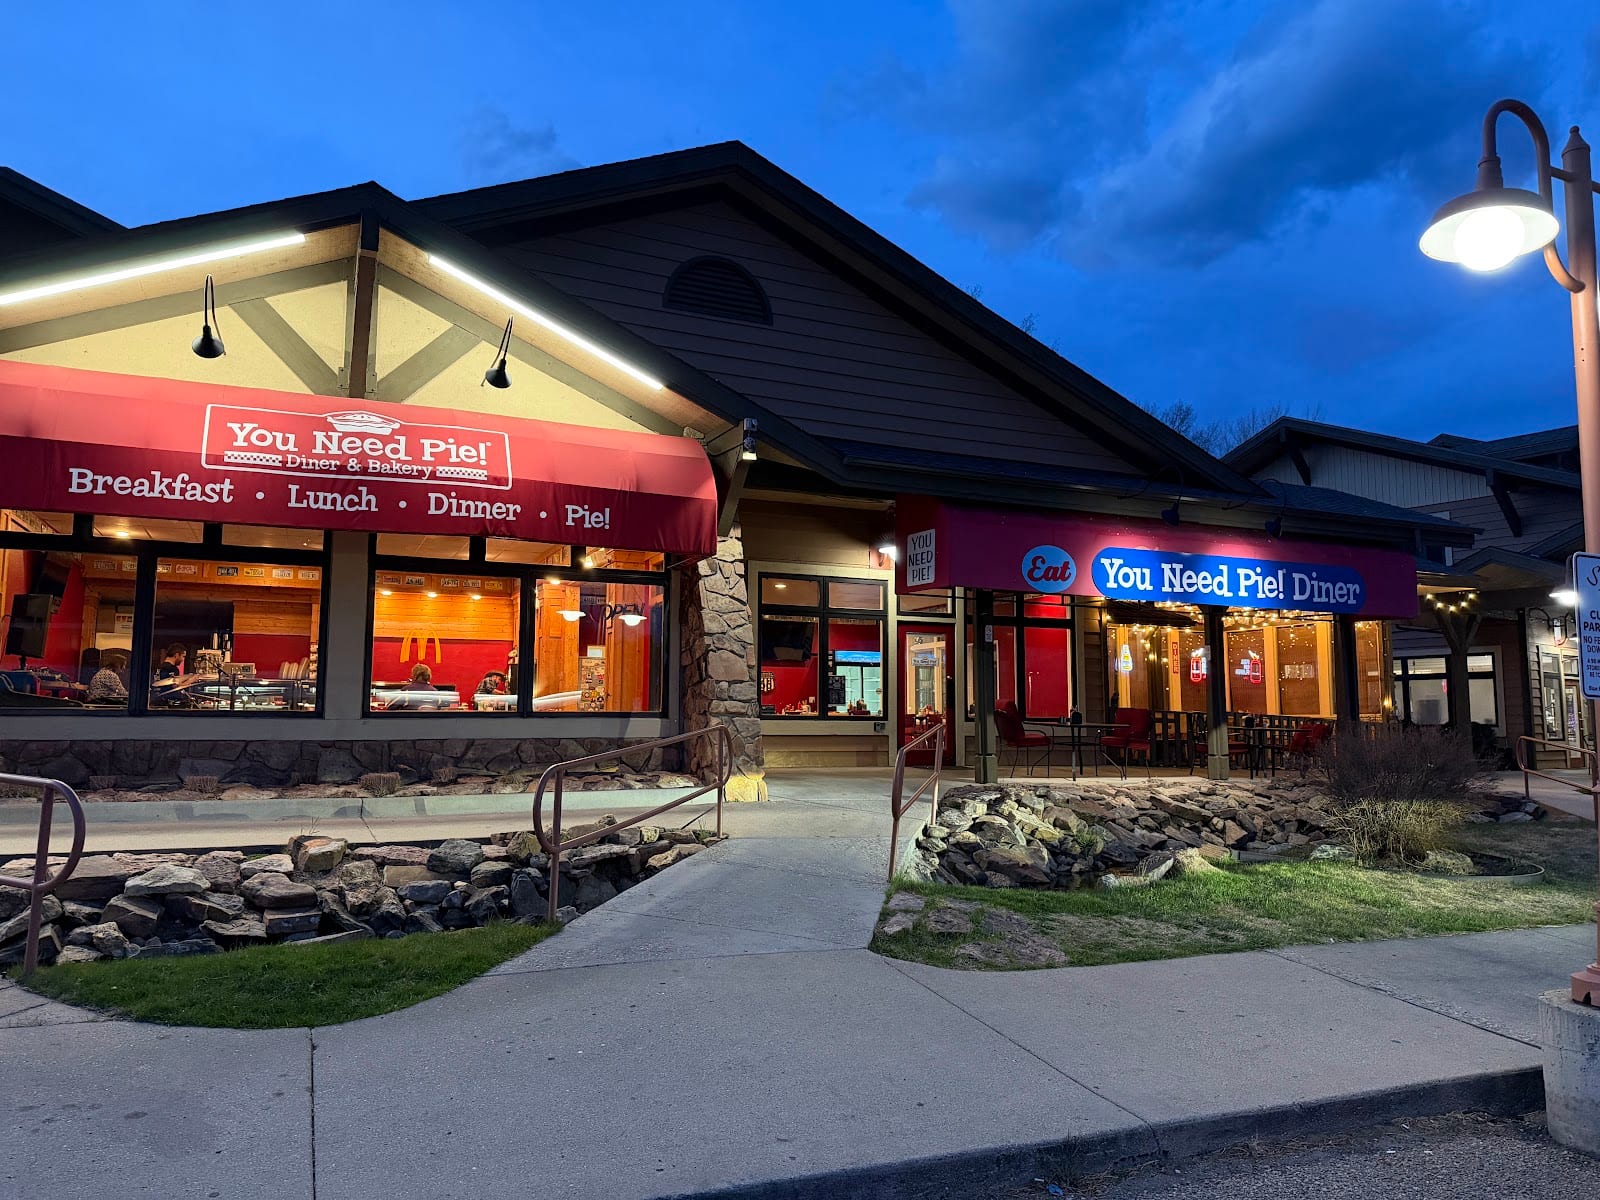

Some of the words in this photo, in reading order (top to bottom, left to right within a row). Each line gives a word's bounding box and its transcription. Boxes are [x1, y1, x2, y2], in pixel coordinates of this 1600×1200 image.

[227, 422, 298, 452] You
[311, 430, 413, 461] Need
[420, 438, 488, 466] Pie!
[286, 454, 340, 471] Diner
[346, 457, 361, 472] &
[367, 459, 433, 480] Bakery
[68, 467, 235, 504] Breakfast
[287, 484, 379, 512] Lunch
[427, 491, 521, 521] Dinner
[565, 504, 611, 530] Pie!
[911, 532, 932, 551] YOU
[908, 550, 934, 567] NEED
[1027, 555, 1072, 583] Eat
[912, 565, 932, 583] PIE!
[1100, 557, 1154, 591] You
[1161, 563, 1233, 597] Need
[1237, 566, 1285, 600] Pie!
[1292, 571, 1360, 605] Diner
